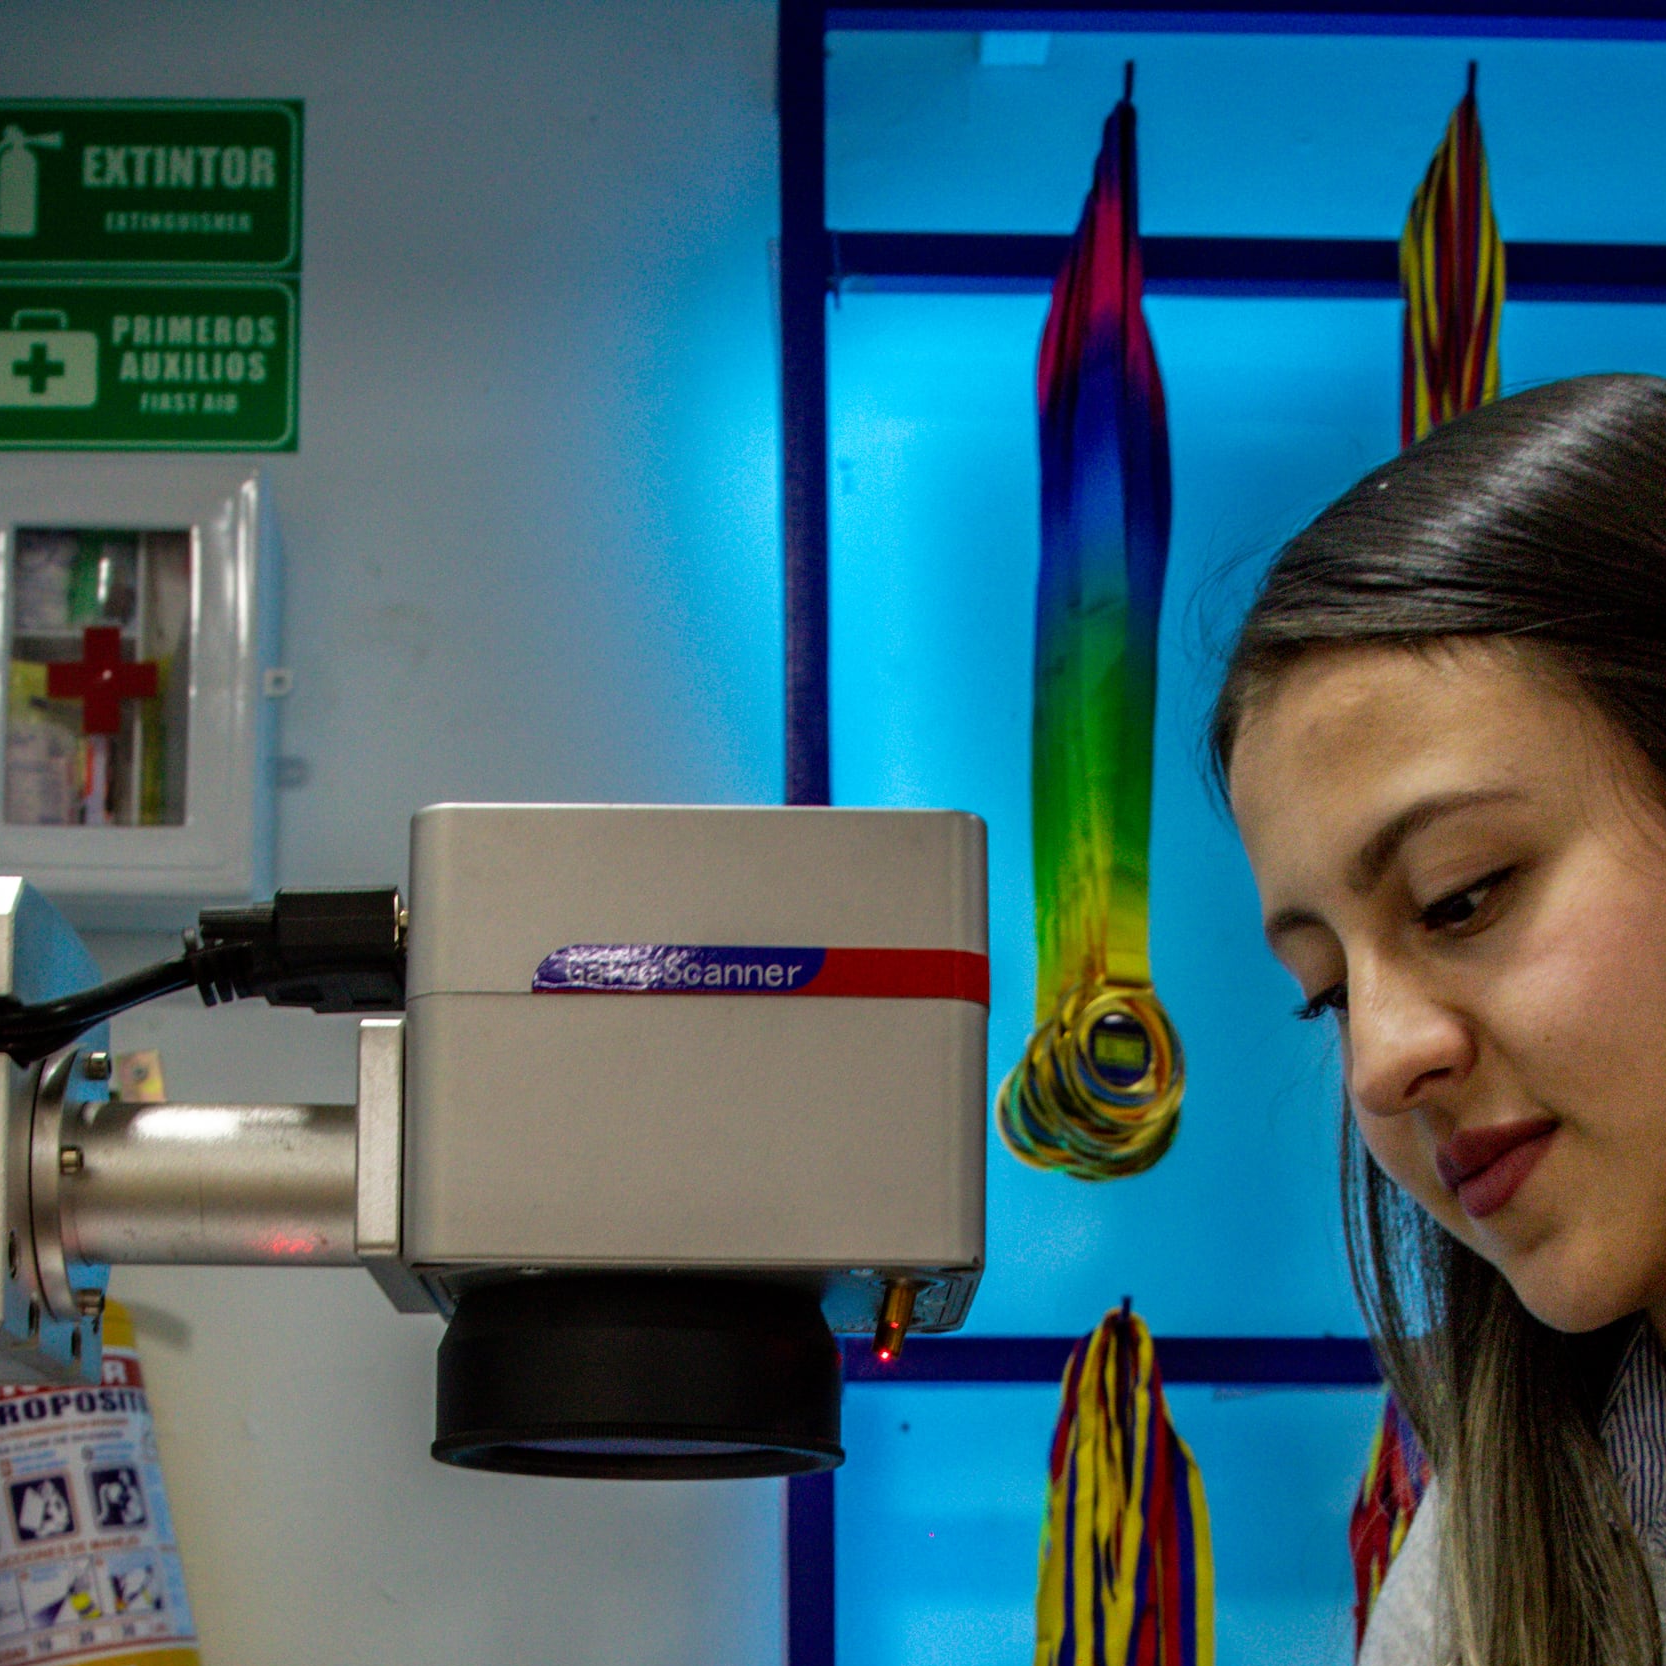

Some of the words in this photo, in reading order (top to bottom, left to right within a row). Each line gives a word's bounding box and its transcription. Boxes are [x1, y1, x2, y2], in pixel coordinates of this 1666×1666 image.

[83, 146, 277, 188] EXTINTOR
[111, 314, 277, 346] PRIMEROS
[120, 350, 268, 383] AUXILIOS
[139, 391, 198, 414] FIRST
[201, 391, 240, 414] AID
[661, 955, 803, 987] Scanner
